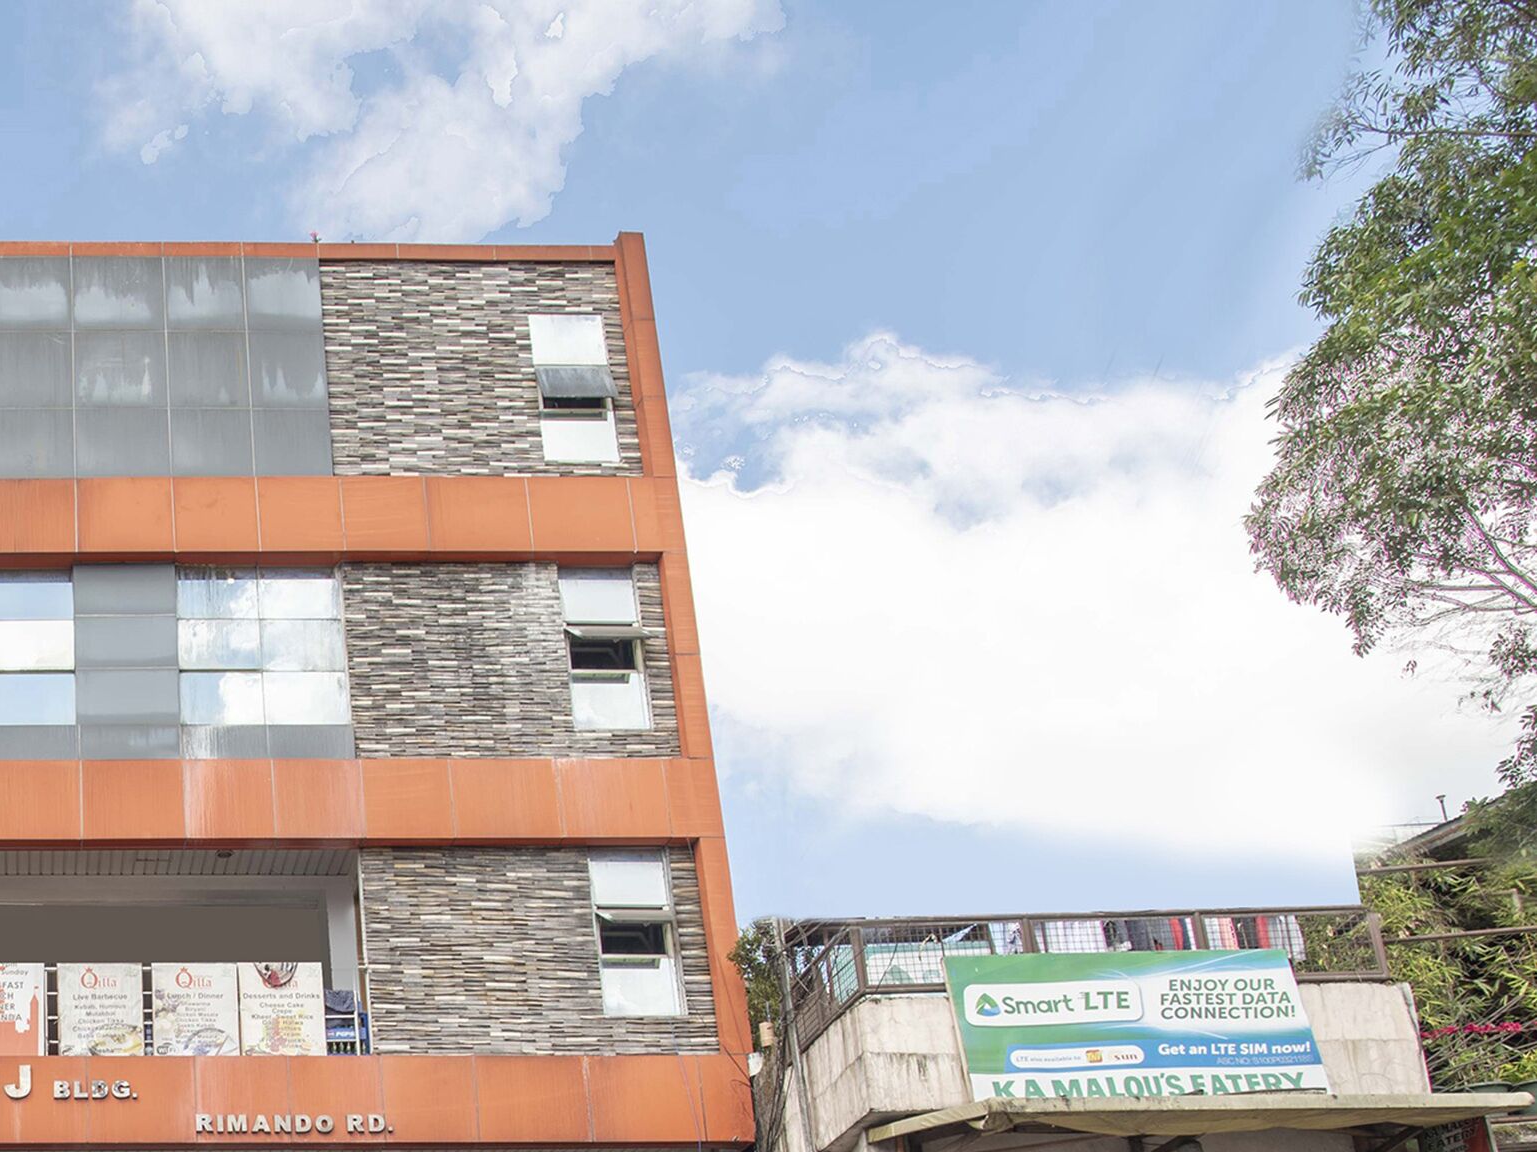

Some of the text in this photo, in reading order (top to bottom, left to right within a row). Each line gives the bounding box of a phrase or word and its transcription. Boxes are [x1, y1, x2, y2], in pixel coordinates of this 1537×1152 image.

[80, 966, 117, 989] Qilla
[175, 966, 212, 989] Qilla
[1168, 978, 1275, 992] ENJOY OUR
[1001, 991, 1130, 1015] Smart LTE
[1160, 991, 1291, 1006] FASTEST DATA
[1160, 1005, 1296, 1020] CONNECTION!
[1157, 1040, 1311, 1056] Get an LTE SIM now!
[53, 1080, 138, 1100] BLDG.
[1051, 1072, 1185, 1098] MALOU'S
[1189, 1071, 1304, 1097] EATERY
[195, 1113, 395, 1134] RIMANDO RD.
